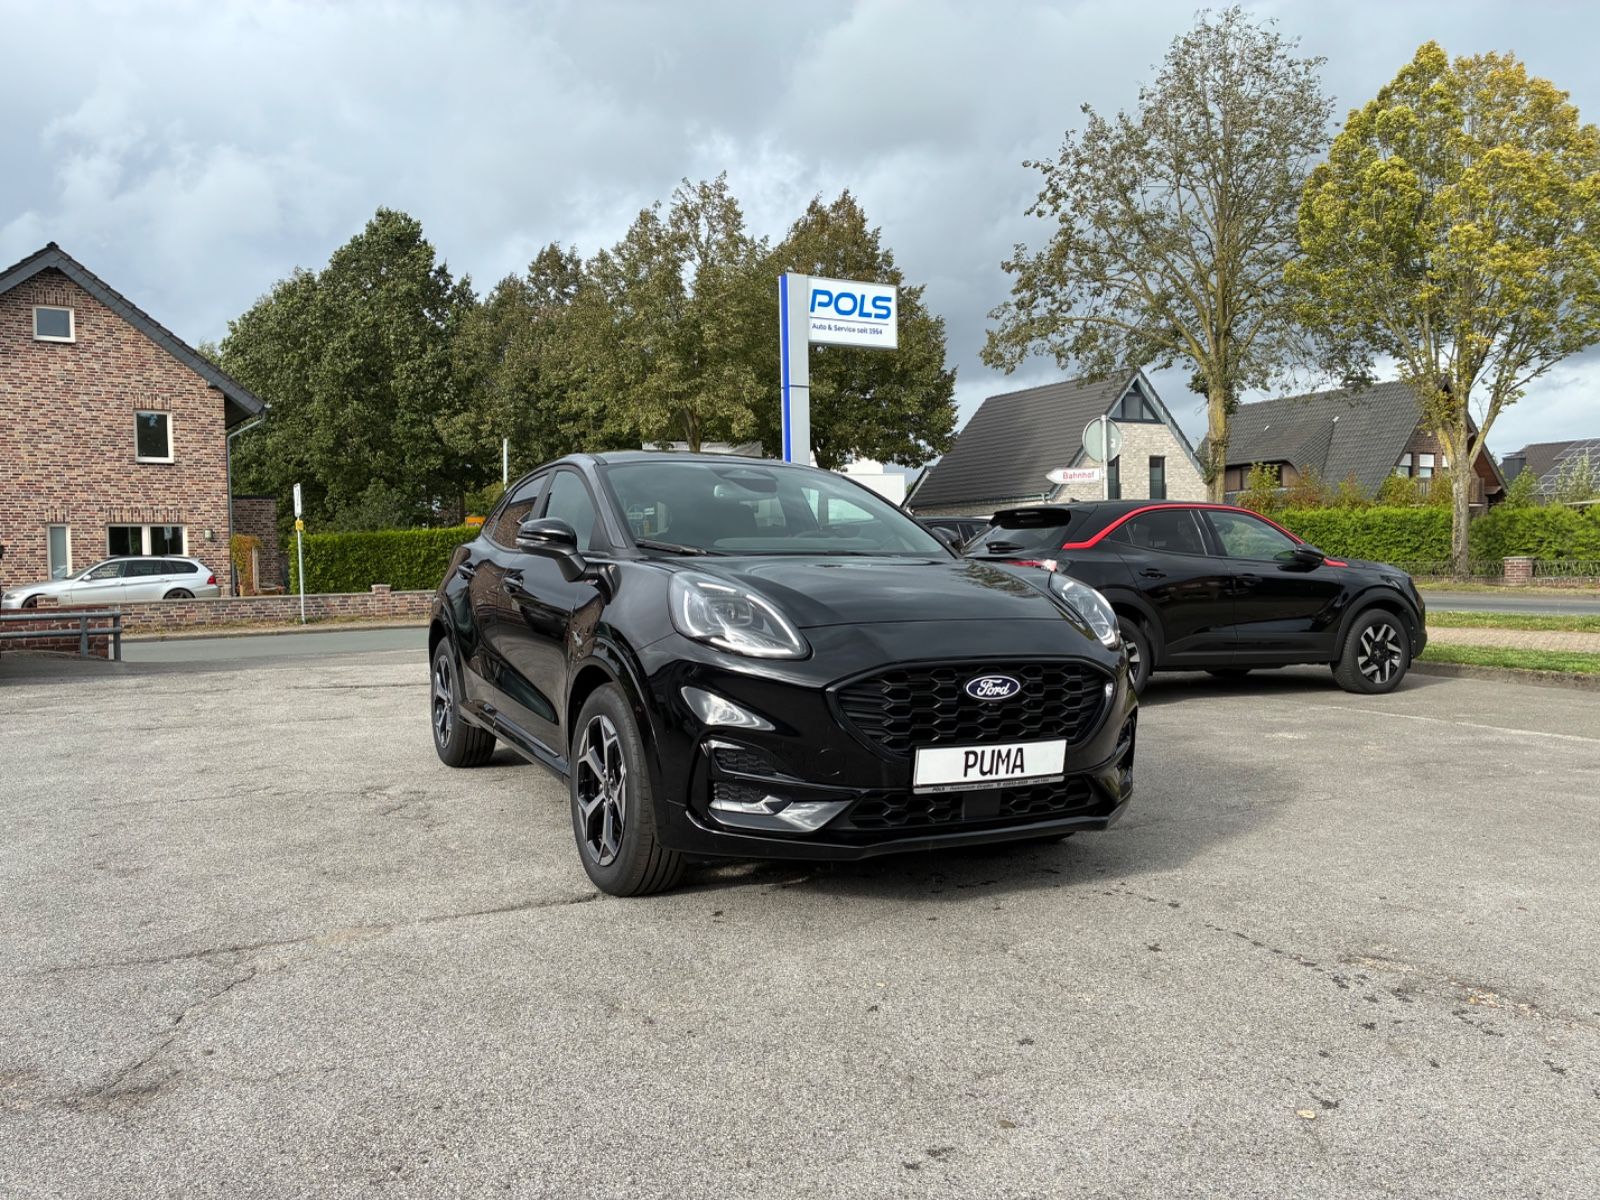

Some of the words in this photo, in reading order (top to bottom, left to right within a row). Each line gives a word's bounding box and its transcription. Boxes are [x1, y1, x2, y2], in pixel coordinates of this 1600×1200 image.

[810, 289, 892, 319] POLS
[834, 324, 856, 333] Service
[857, 326, 868, 334] seit
[1062, 472, 1094, 480] Bahnhof
[976, 679, 1010, 696] Ford
[964, 747, 1024, 777] PUMA
